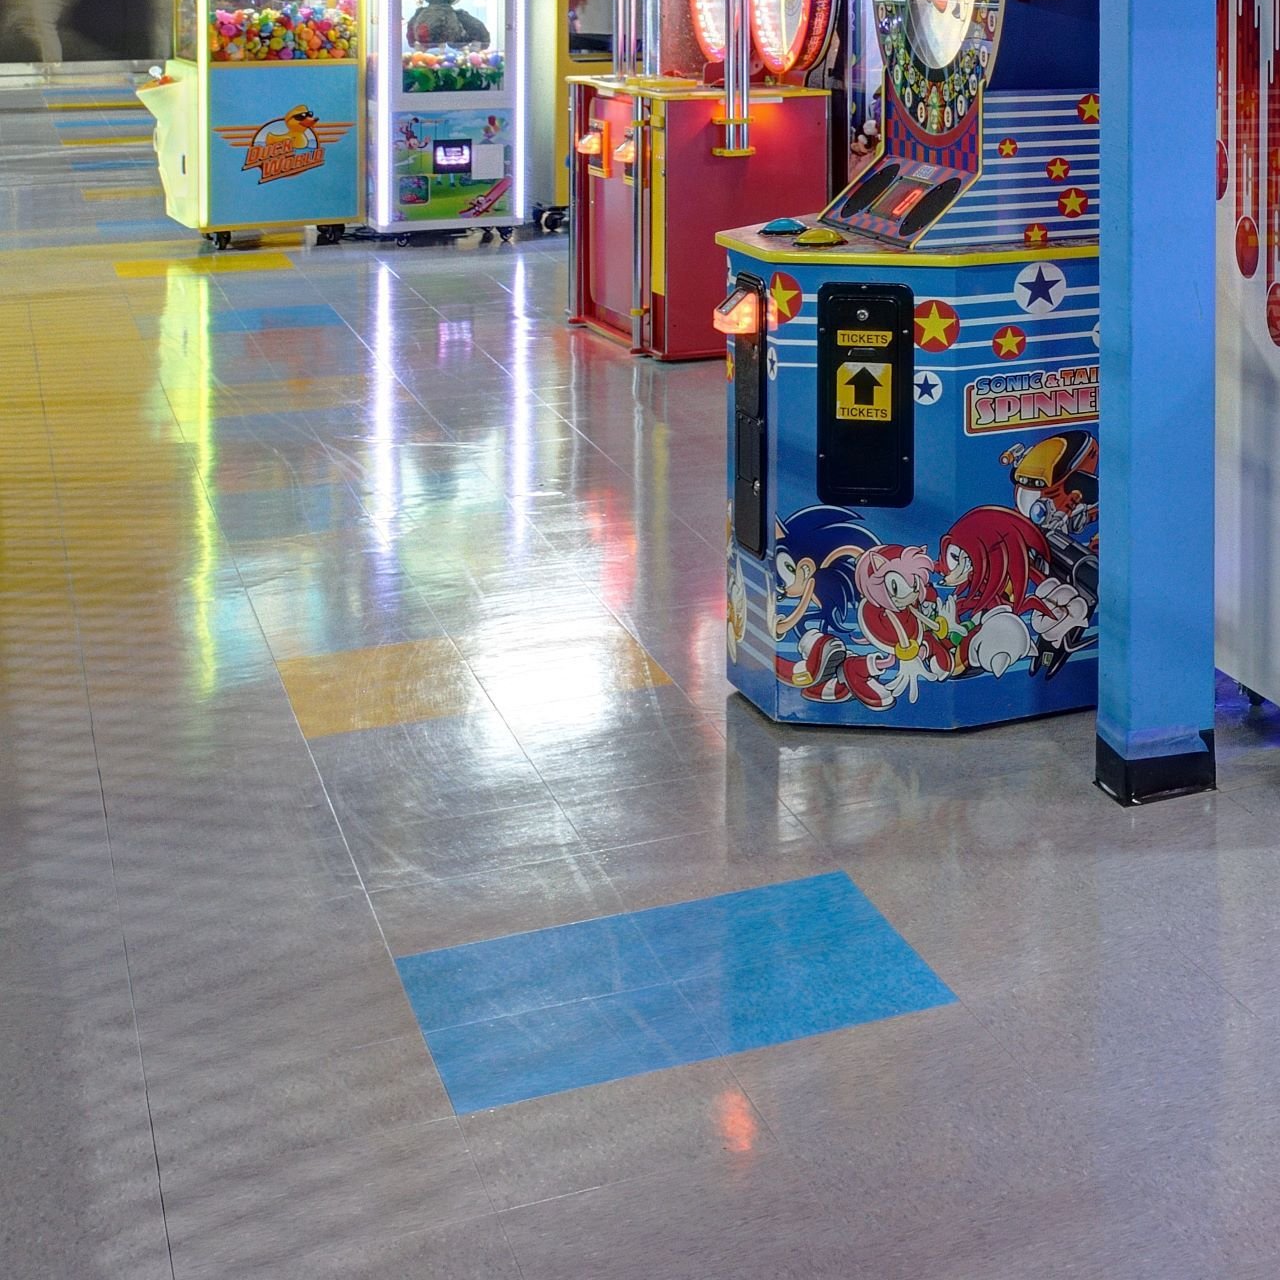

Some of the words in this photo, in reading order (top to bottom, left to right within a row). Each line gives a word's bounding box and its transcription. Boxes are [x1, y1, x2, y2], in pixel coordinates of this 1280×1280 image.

[246, 138, 294, 164] DUCK
[262, 148, 325, 179] WORLD
[839, 333, 888, 345] TICKETS
[976, 372, 1043, 395] SONIC
[1044, 374, 1060, 388] &
[839, 407, 888, 419] TICKETS
[975, 386, 1099, 425] SPINNE
